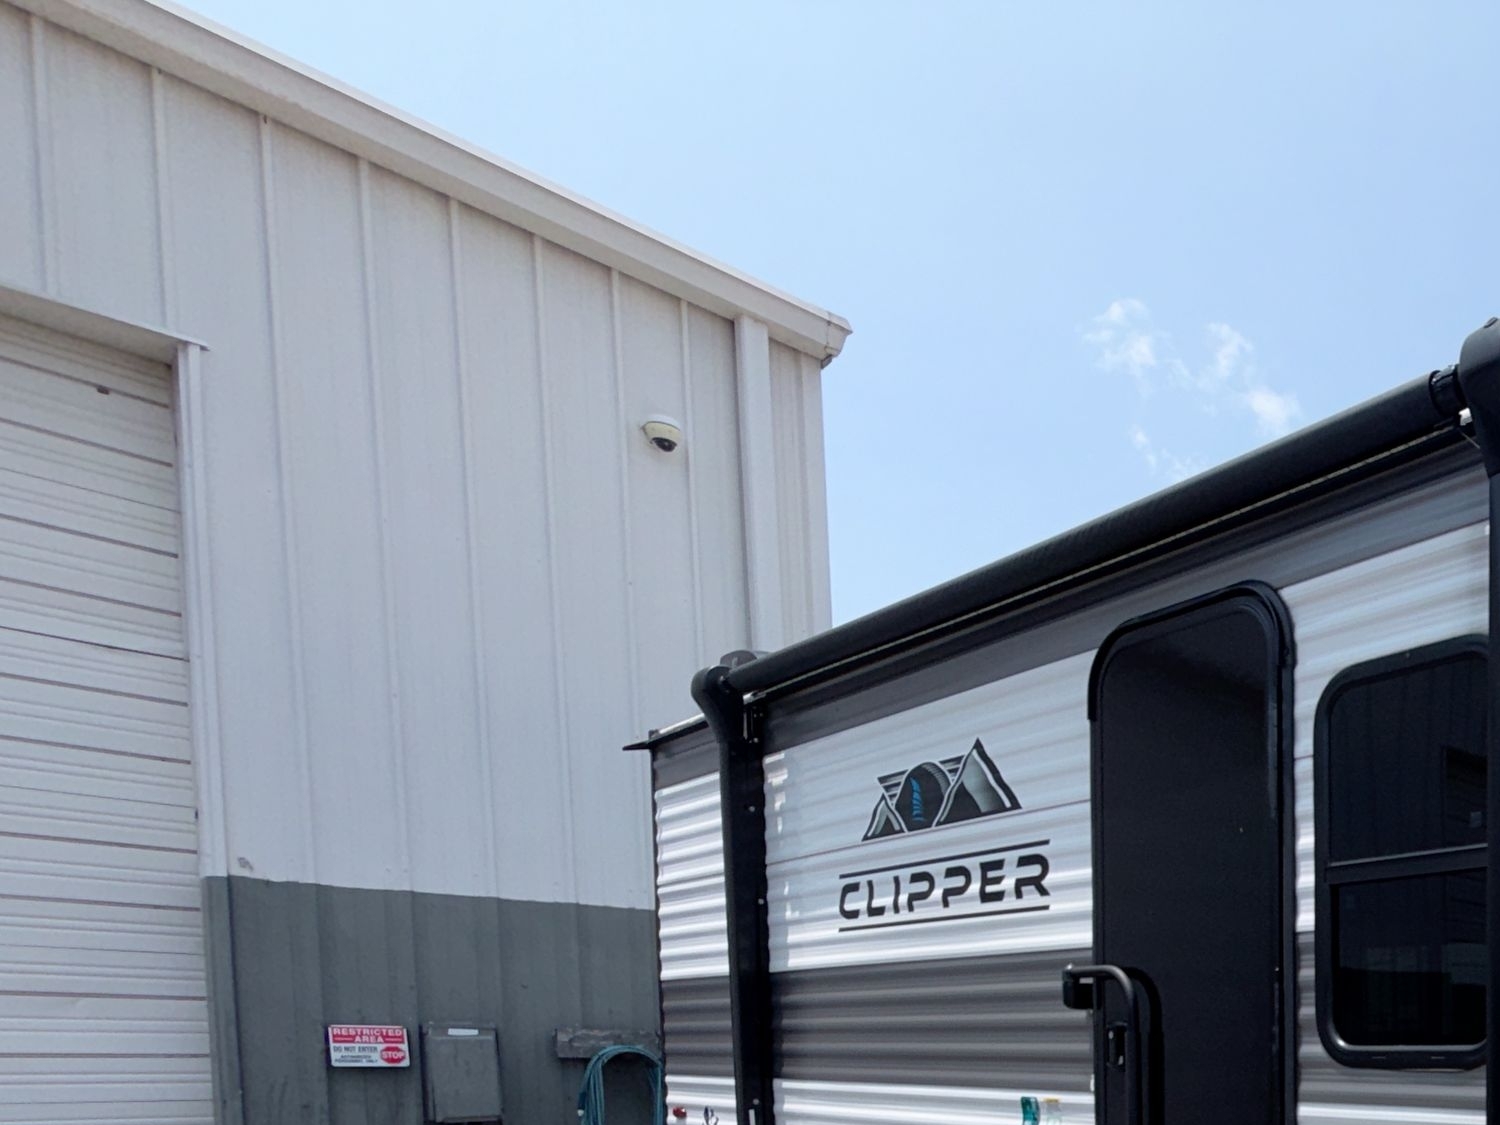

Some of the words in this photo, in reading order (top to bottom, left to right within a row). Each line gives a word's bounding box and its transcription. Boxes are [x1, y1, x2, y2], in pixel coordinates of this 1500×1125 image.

[839, 853, 1051, 920] CLIPPER
[332, 1027, 403, 1037] RESTRICTED
[354, 1035, 385, 1043] AREA
[382, 1051, 405, 1059] STOP
